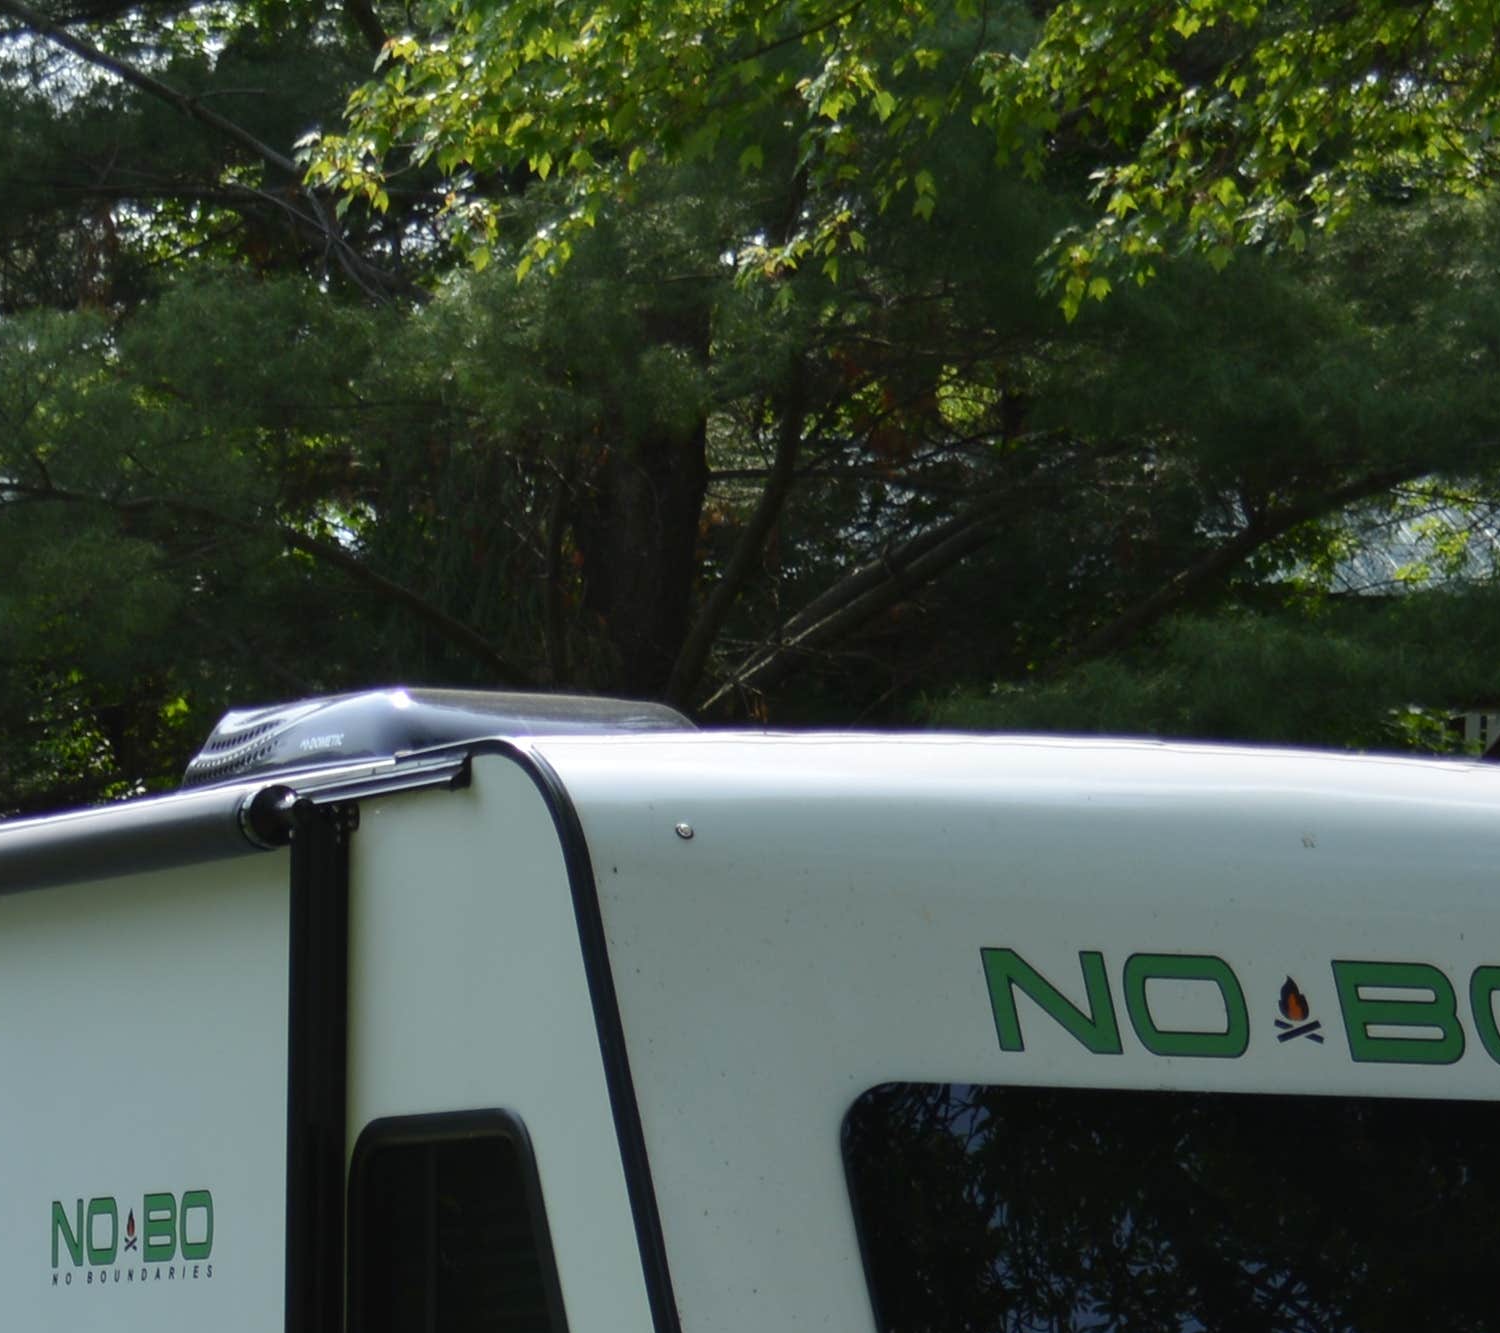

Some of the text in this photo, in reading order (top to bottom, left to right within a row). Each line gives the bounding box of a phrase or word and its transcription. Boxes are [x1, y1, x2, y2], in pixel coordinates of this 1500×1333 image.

[980, 947, 1251, 1058] NO
[51, 1189, 214, 1268] NO BO
[51, 1264, 213, 1286] NO BOUNDARIES
